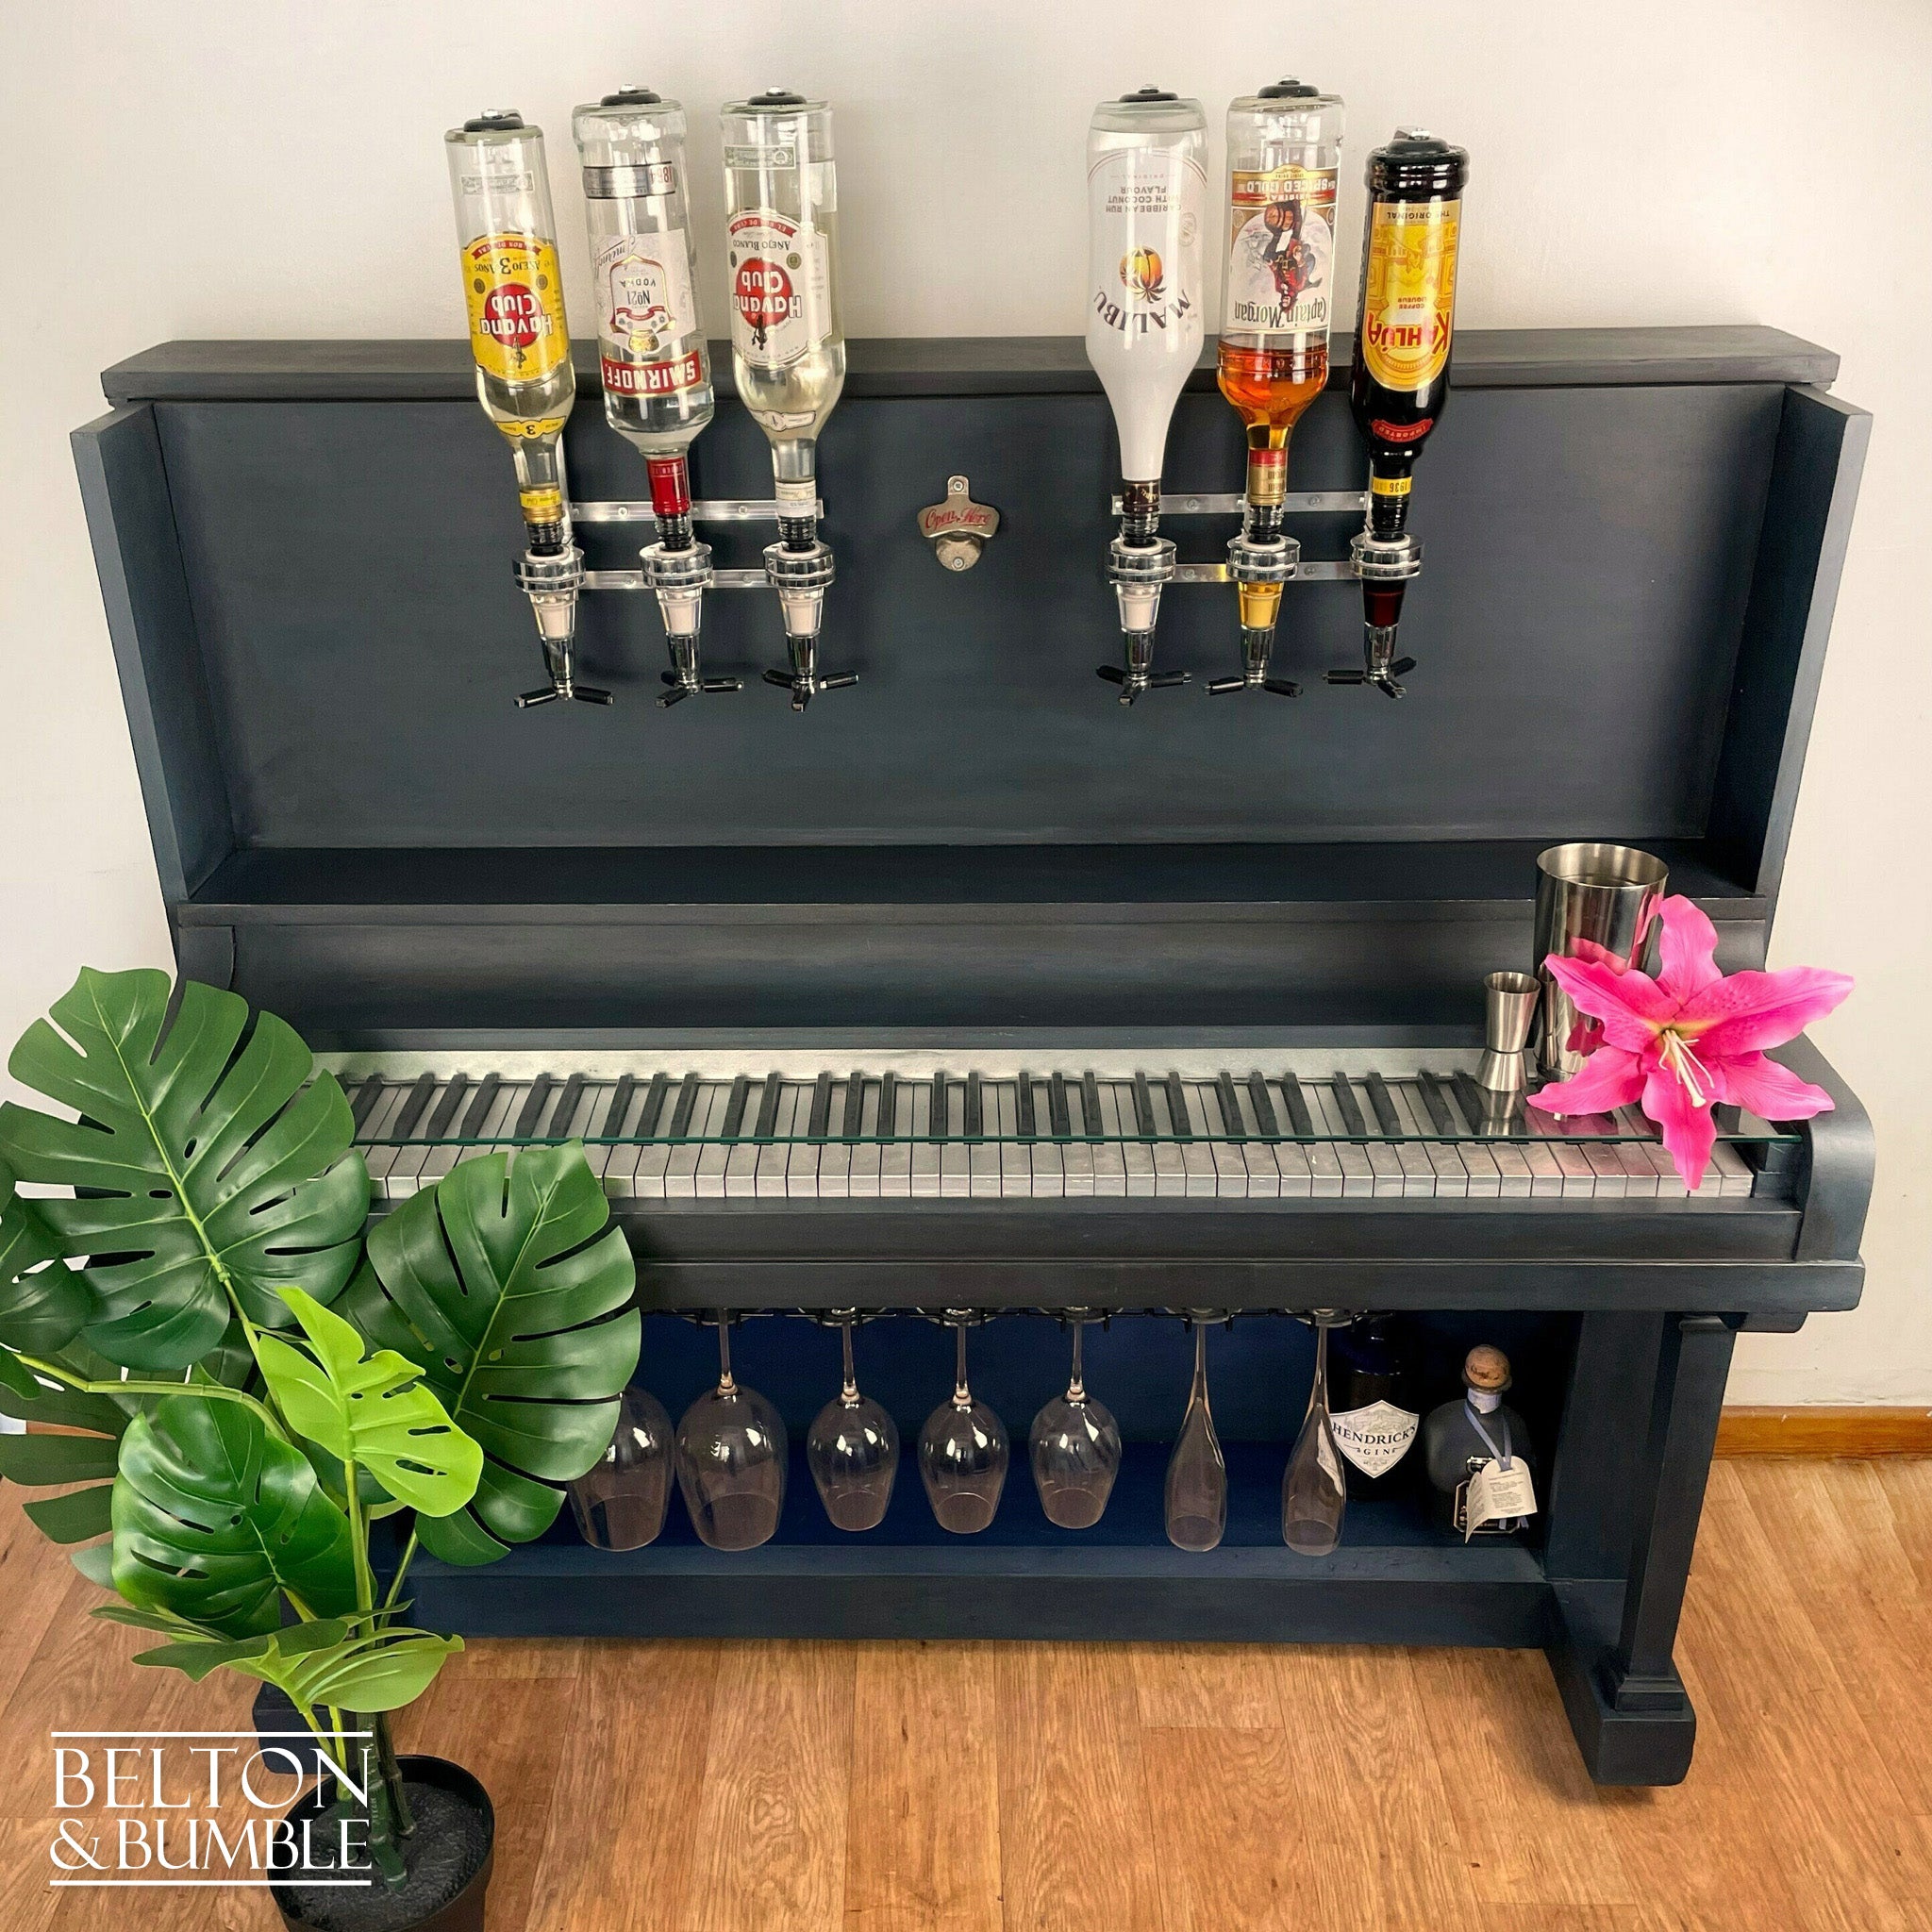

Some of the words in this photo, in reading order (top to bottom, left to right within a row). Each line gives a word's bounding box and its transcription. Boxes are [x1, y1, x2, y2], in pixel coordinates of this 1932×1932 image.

[1246, 180, 1279, 193] GOLD
[1106, 205, 1122, 213] RUM
[1107, 195, 1152, 204] COCONUT
[499, 258, 511, 275] 3
[741, 271, 783, 293] Club
[491, 294, 536, 316] Club
[733, 293, 802, 318] Havana
[1094, 290, 1191, 333] MALIBU
[1234, 301, 1284, 328] Morgan
[1286, 297, 1326, 326] Captain
[480, 313, 553, 337] Havana
[607, 359, 695, 390] SMIRNOFF
[525, 425, 536, 435] 3
[1378, 425, 1425, 437] IMPORTED
[1389, 481, 1407, 492] 1936
[925, 508, 958, 531] Open
[958, 507, 992, 526] Here
